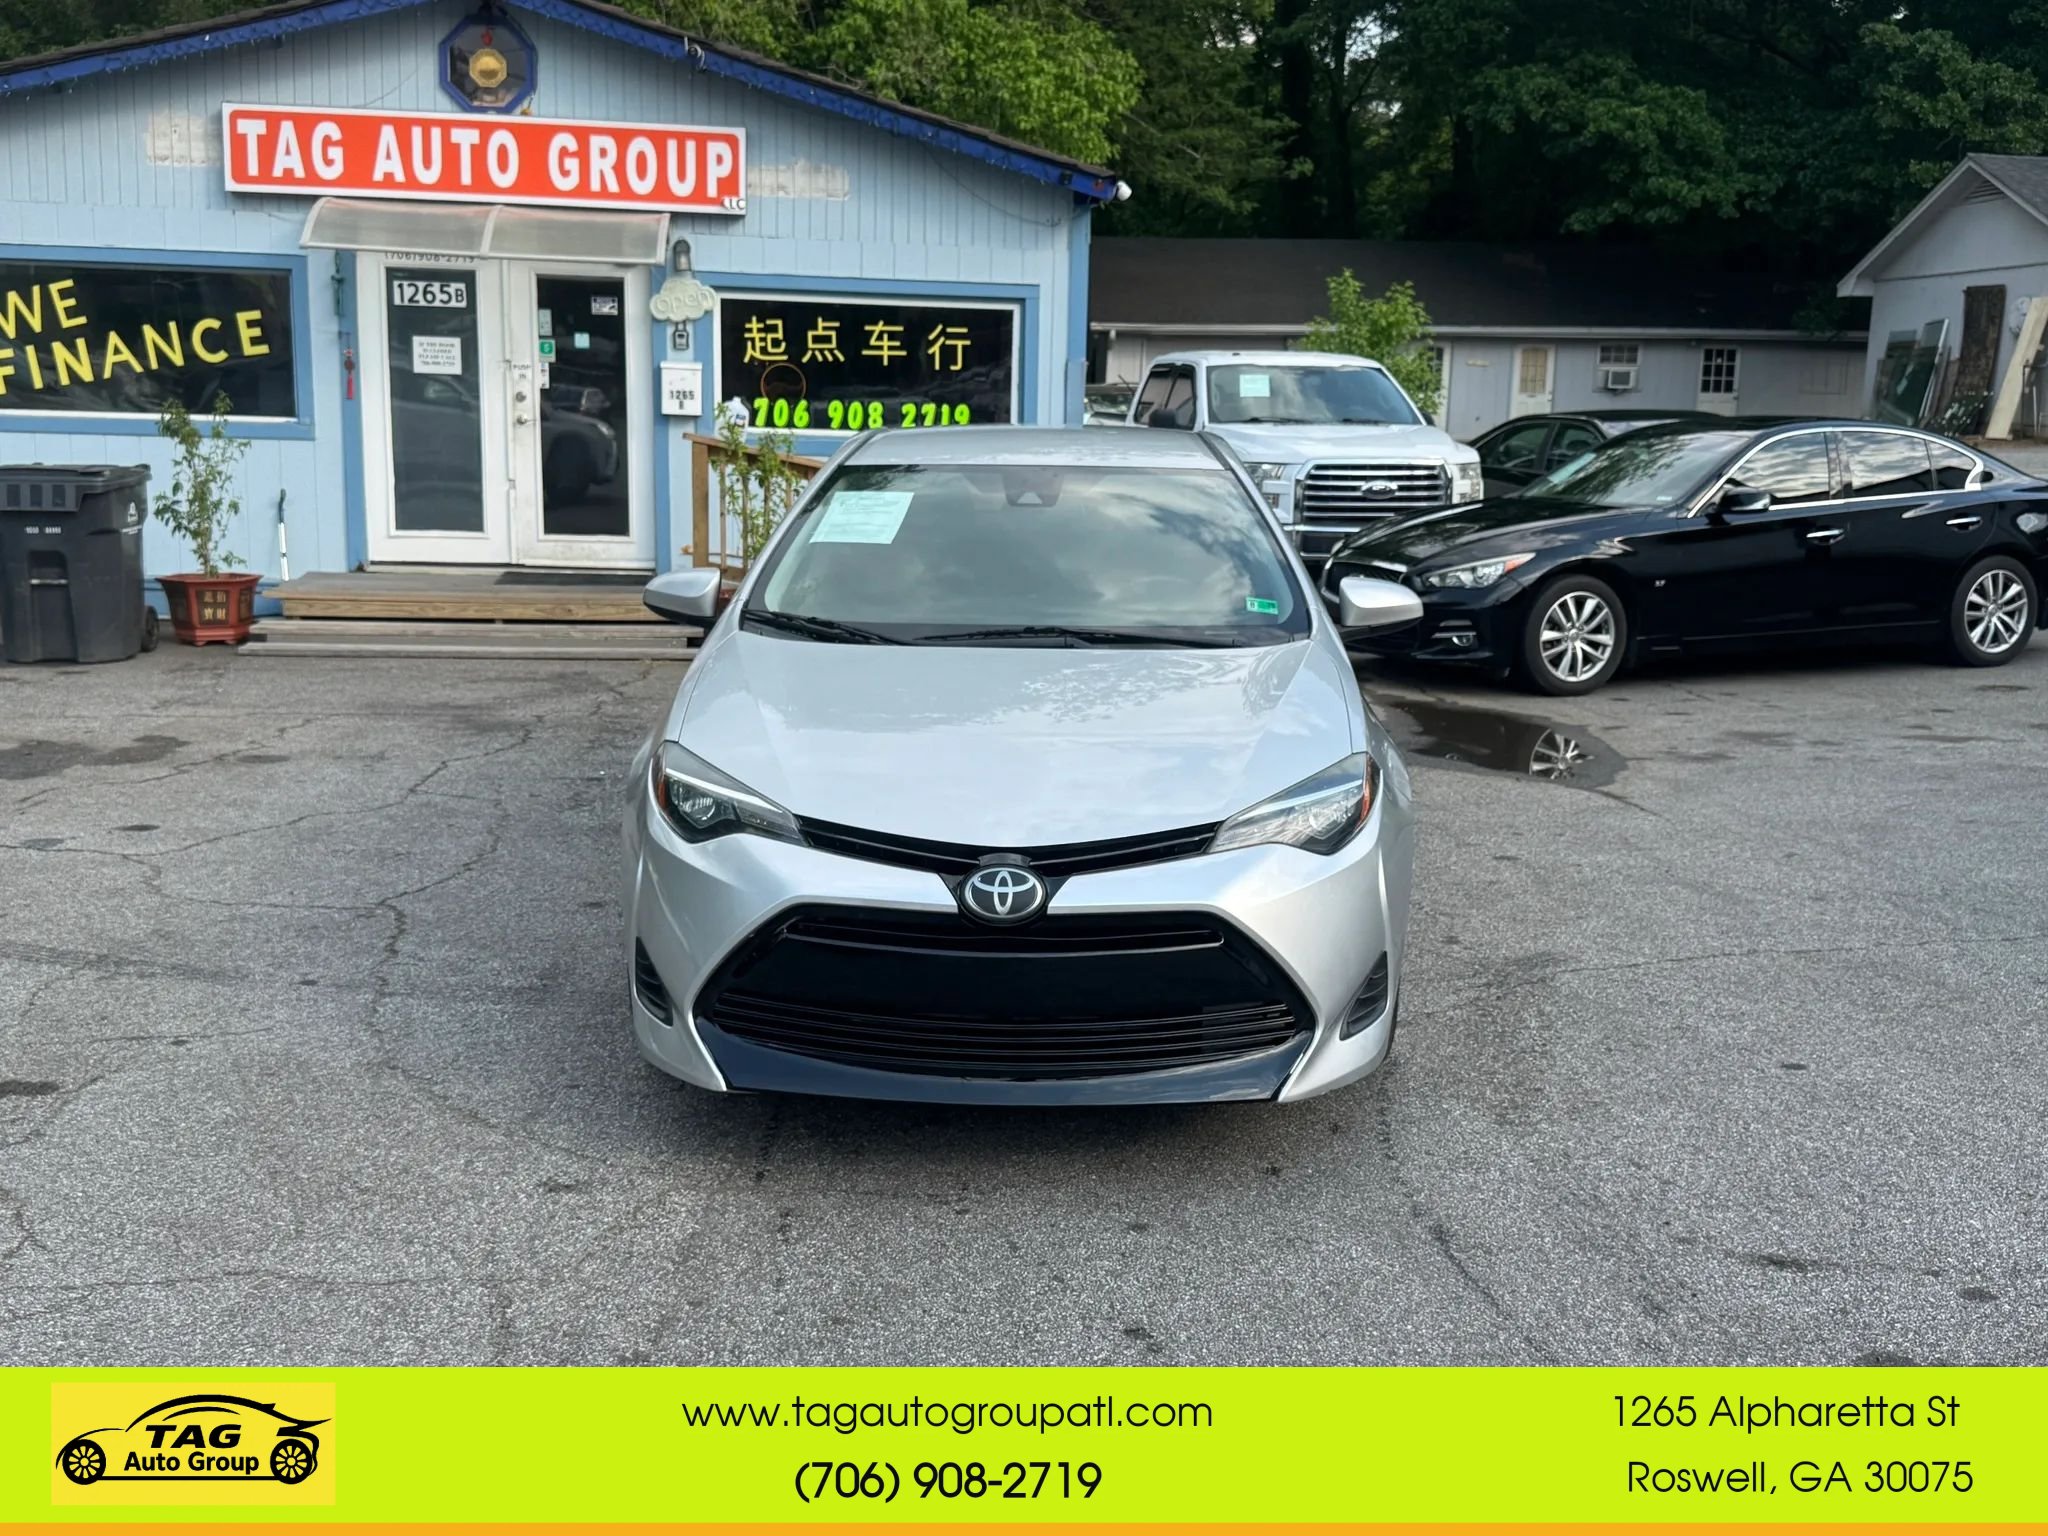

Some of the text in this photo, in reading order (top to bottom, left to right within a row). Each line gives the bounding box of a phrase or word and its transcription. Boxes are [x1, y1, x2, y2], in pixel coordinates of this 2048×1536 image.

[237, 118, 733, 198] TAG AUTO GROUP
[0, 279, 88, 340] WE
[743, 315, 971, 371] 起点车行
[669, 390, 695, 401] 1265
[753, 397, 971, 430] 706 908 2719
